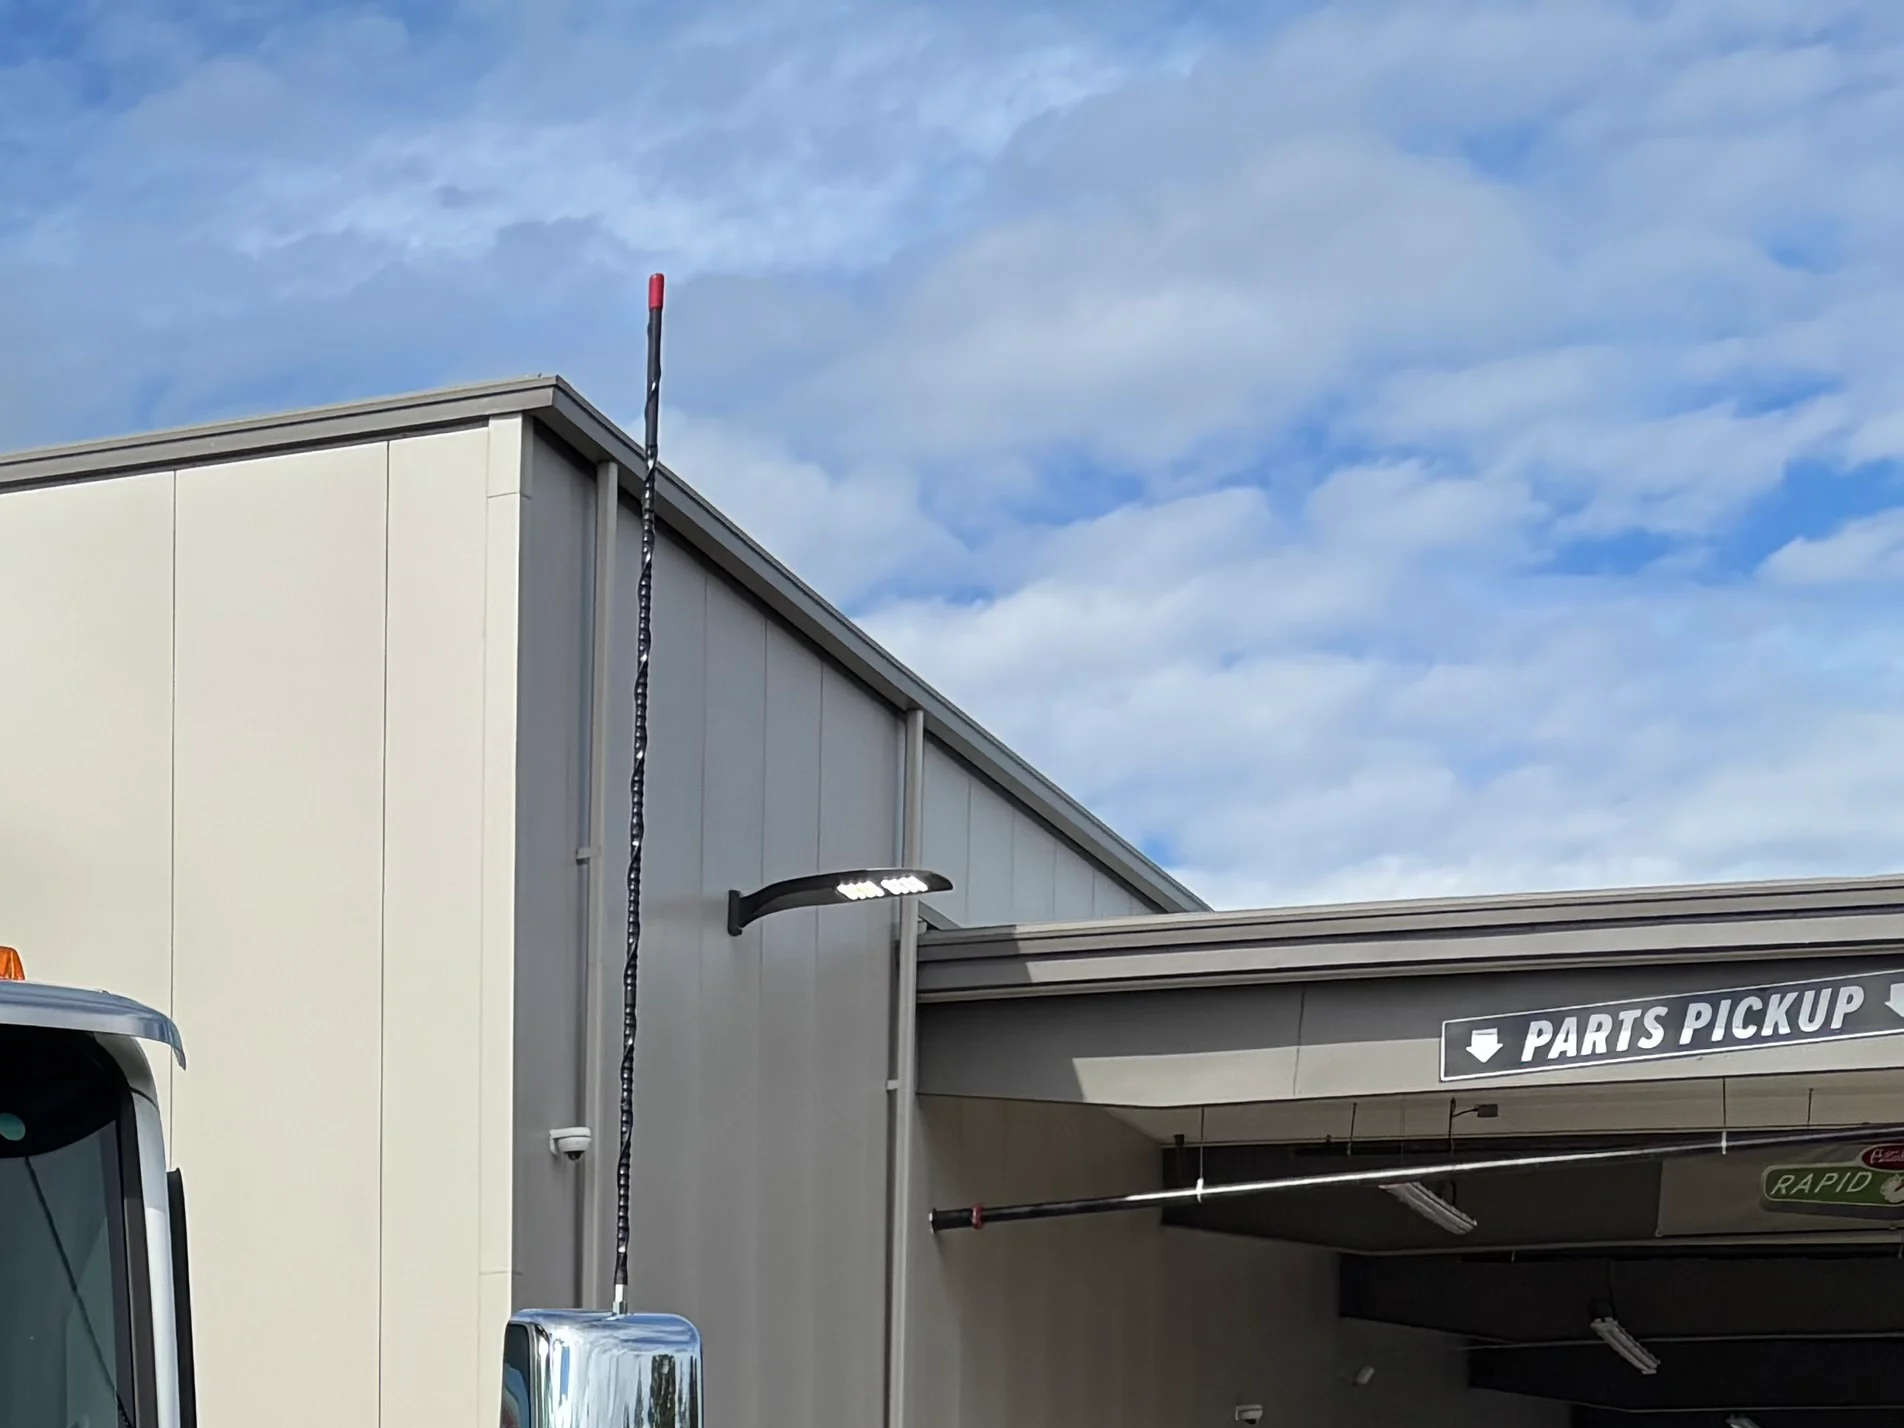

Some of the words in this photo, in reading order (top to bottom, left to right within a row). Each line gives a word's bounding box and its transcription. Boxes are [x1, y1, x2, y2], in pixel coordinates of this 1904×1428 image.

[1520, 1005, 1669, 1063] PARTS
[1678, 985, 1865, 1046] PICKUP
[1770, 1171, 1873, 1196] RAPID
